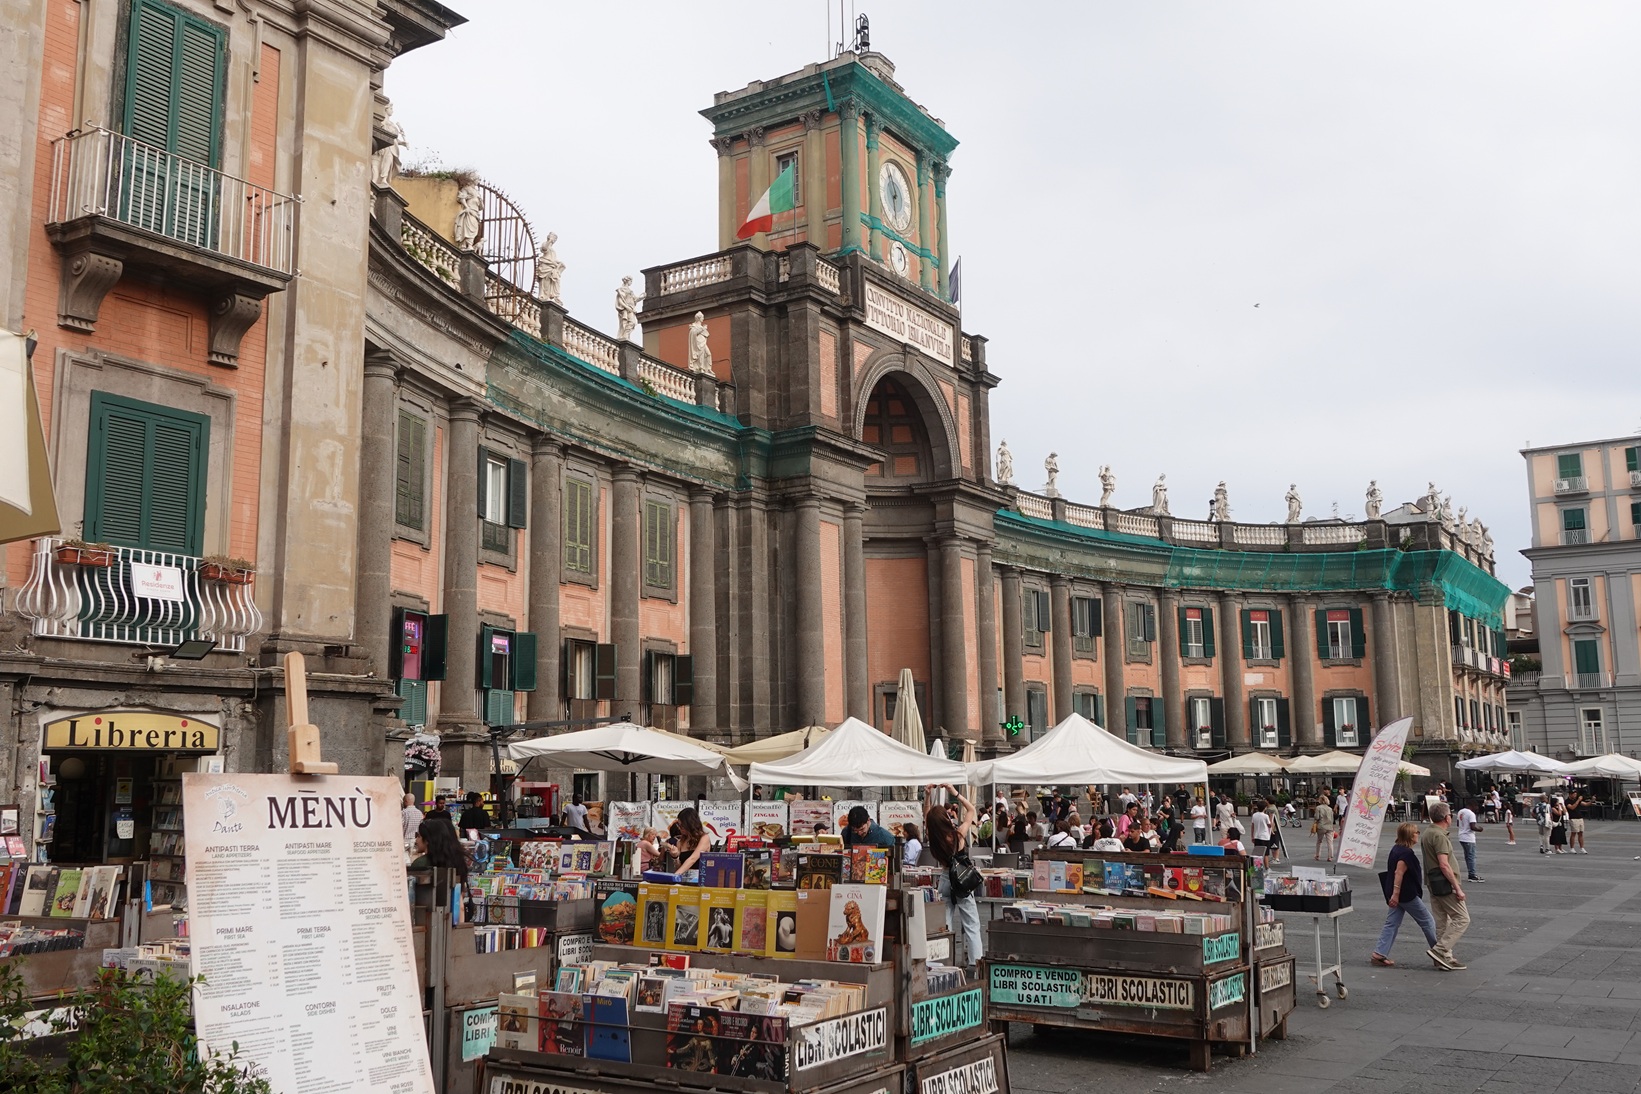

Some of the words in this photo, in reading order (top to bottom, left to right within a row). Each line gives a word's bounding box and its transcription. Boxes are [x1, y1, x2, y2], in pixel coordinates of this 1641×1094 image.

[867, 304, 905, 336] VITTORIO
[141, 580, 175, 590] Residenze
[66, 717, 206, 748] Libreria
[1372, 740, 1402, 753] Spritz
[212, 821, 243, 834] Dante
[805, 855, 839, 869] ICONE
[1341, 848, 1373, 864] Spritz
[563, 937, 585, 947] COMPRO
[586, 936, 590, 944] E
[562, 947, 576, 956] LIBRI
[994, 968, 1033, 979] COMPRO
[1036, 970, 1041, 979] E
[1044, 970, 1078, 981] VENDO
[377, 984, 396, 992] FRUTTA
[993, 980, 1017, 990] LIBRI
[1089, 976, 1118, 1000] LIBRI
[1121, 979, 1189, 1006] SCOLASTICI
[597, 997, 613, 1006] Miró
[1017, 993, 1052, 1004] USATI
[221, 1001, 260, 1012] INSALATONE
[305, 1001, 336, 1011] CONTORNI
[380, 1006, 397, 1014] DOLCE
[912, 1002, 934, 1038] LIBRI
[935, 991, 981, 1033] SCOLASTICI
[465, 1026, 490, 1041] LIBRI
[828, 1010, 885, 1059] SCOLASTICI
[392, 1048, 412, 1056] BIANCHI
[560, 1043, 582, 1054] Renoir
[949, 1059, 997, 1094] SCOLASTICI
